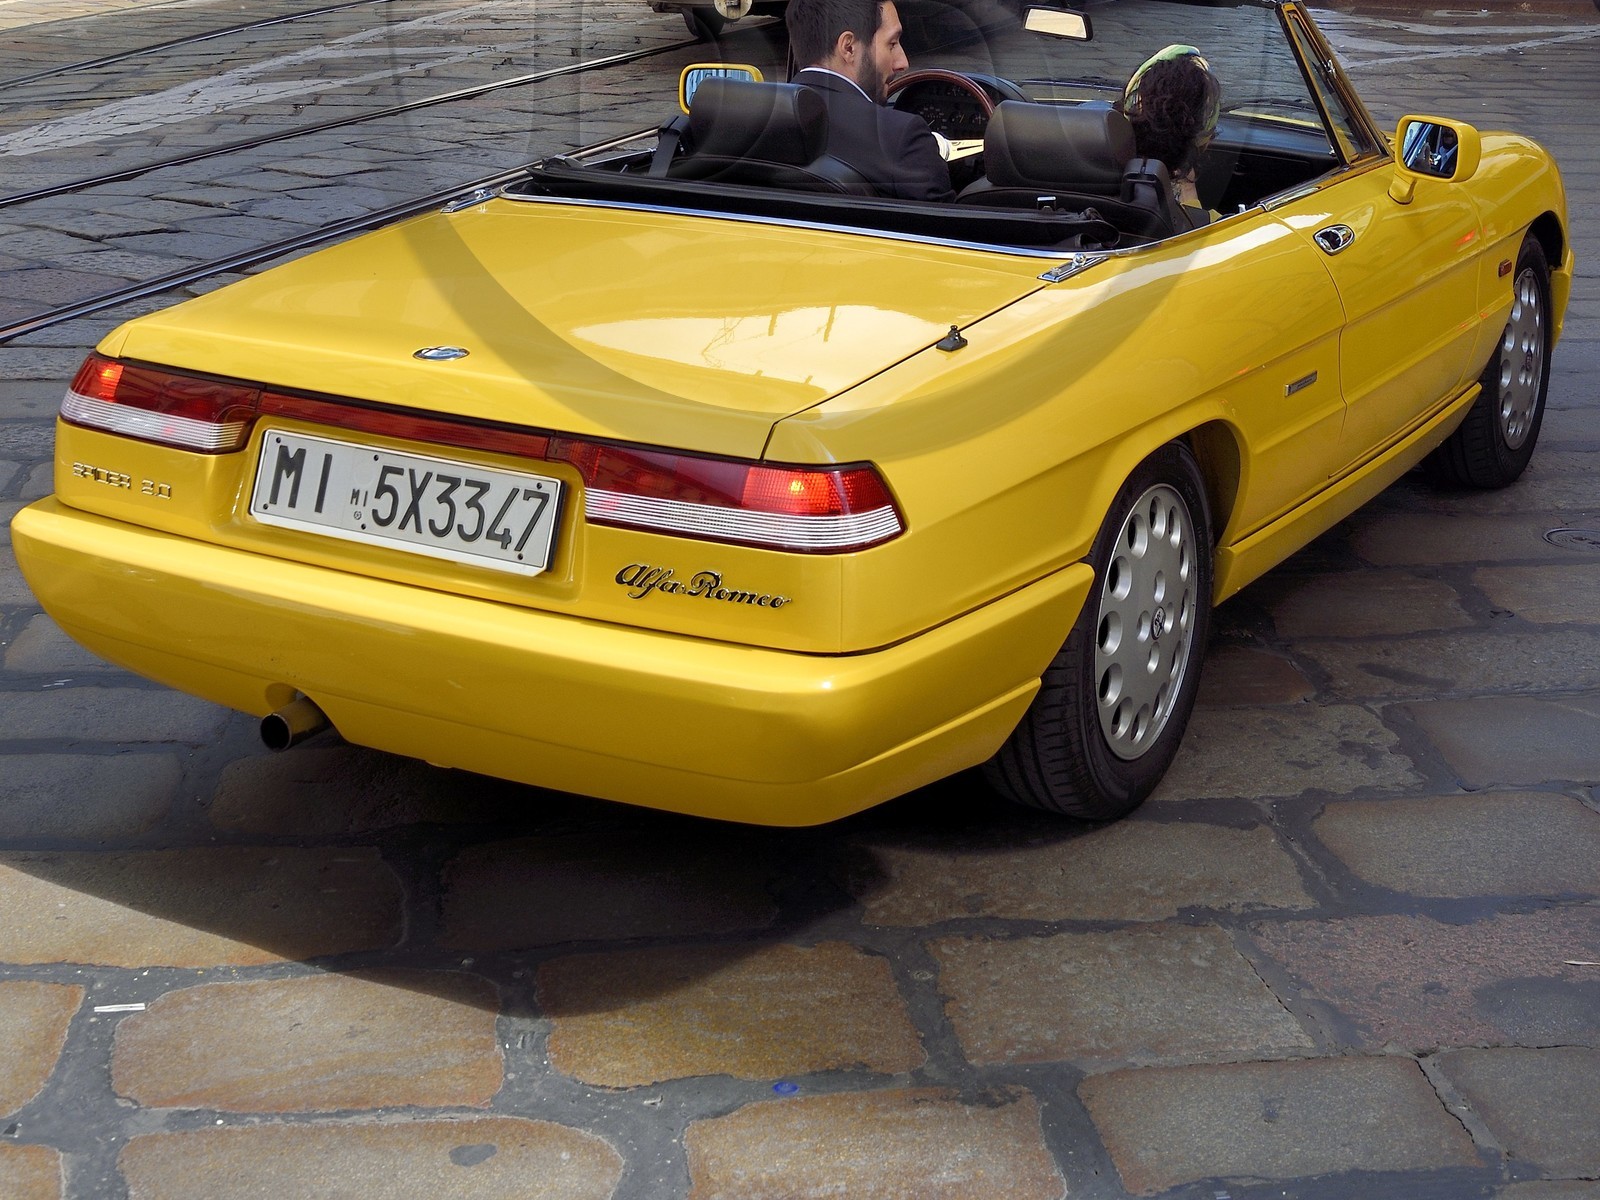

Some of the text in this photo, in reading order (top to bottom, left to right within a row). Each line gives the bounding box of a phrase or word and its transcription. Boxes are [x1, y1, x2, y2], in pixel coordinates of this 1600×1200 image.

[73, 461, 172, 500] SPIDER 2.0
[268, 444, 333, 514] MI
[371, 464, 551, 553] 5X3347
[614, 563, 792, 609] Alfa Romeo
